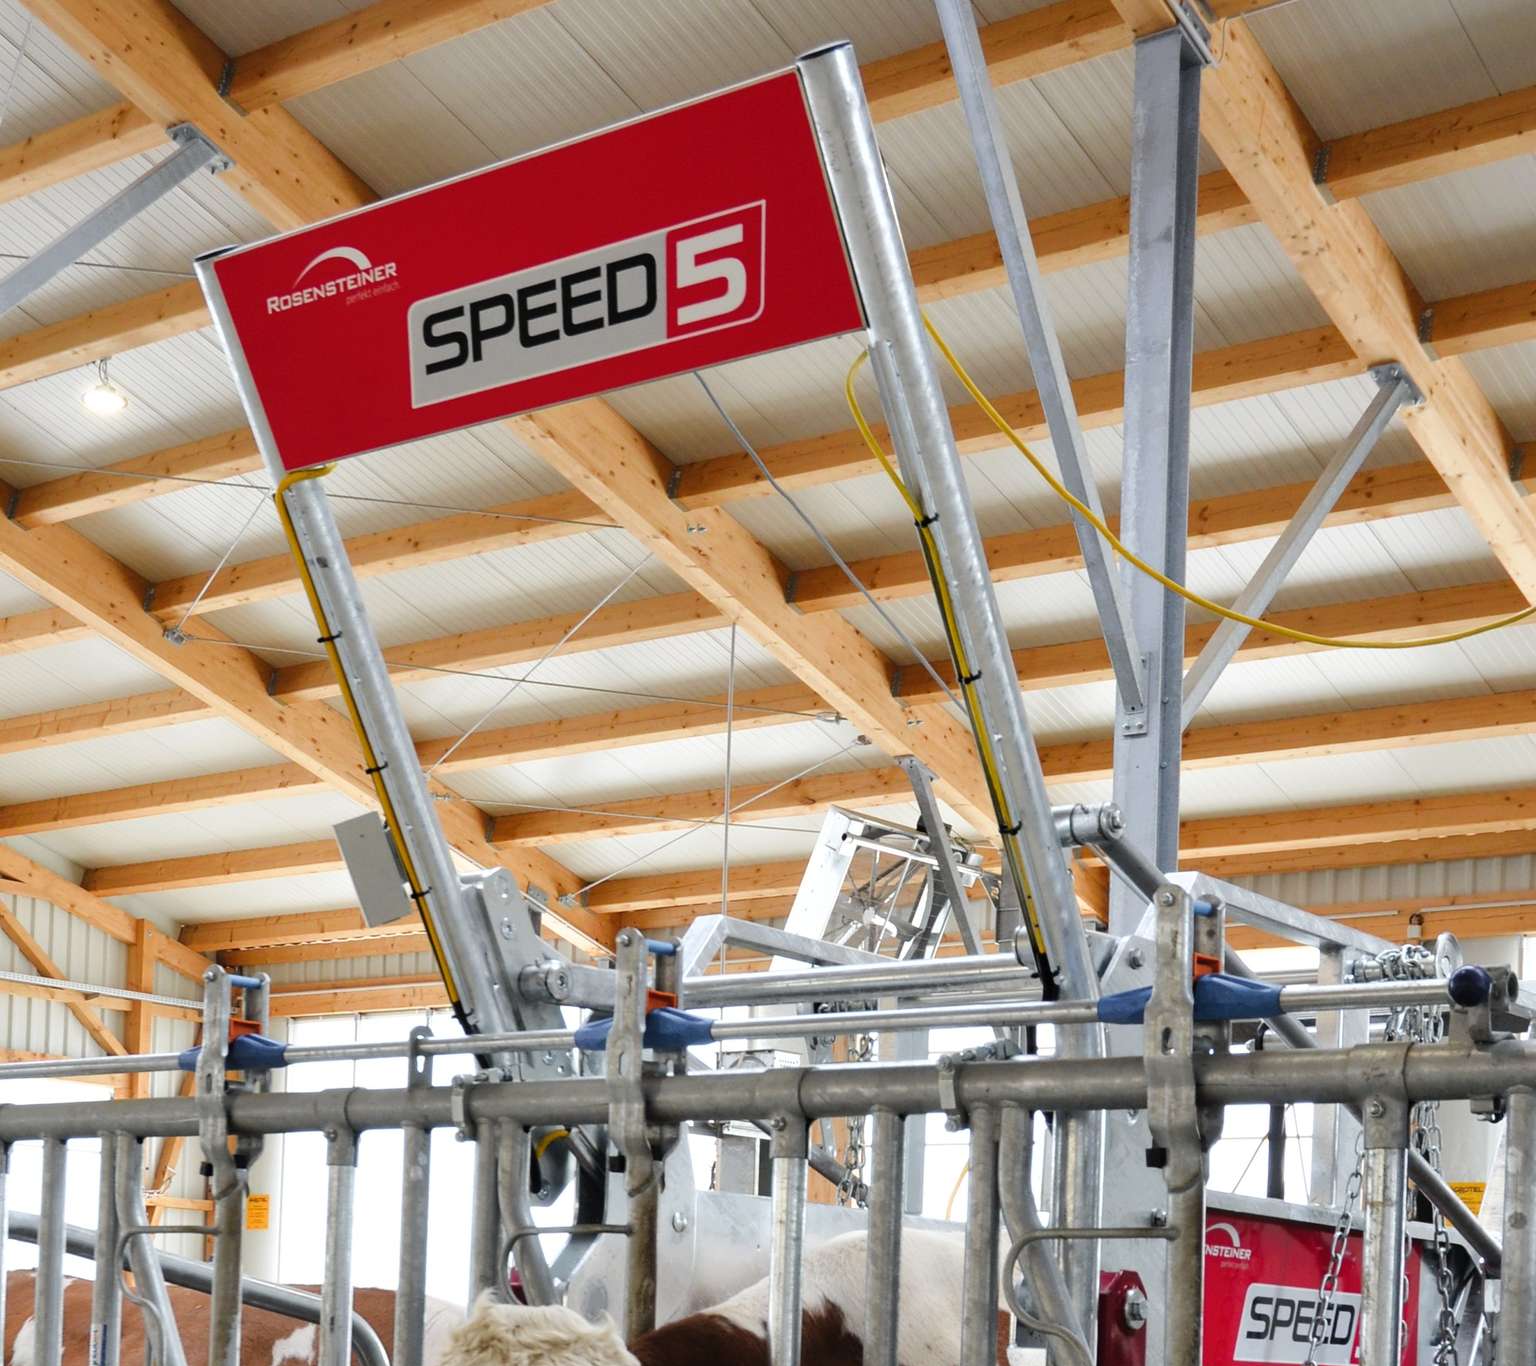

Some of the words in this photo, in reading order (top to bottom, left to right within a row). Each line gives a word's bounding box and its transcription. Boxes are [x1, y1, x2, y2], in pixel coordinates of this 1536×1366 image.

[266, 262, 398, 315] ROSENSTEINER
[422, 252, 658, 376] SPEED
[675, 222, 747, 327] 5
[1205, 1244, 1252, 1260] NSTEINER
[1246, 1296, 1355, 1345] SPEED
